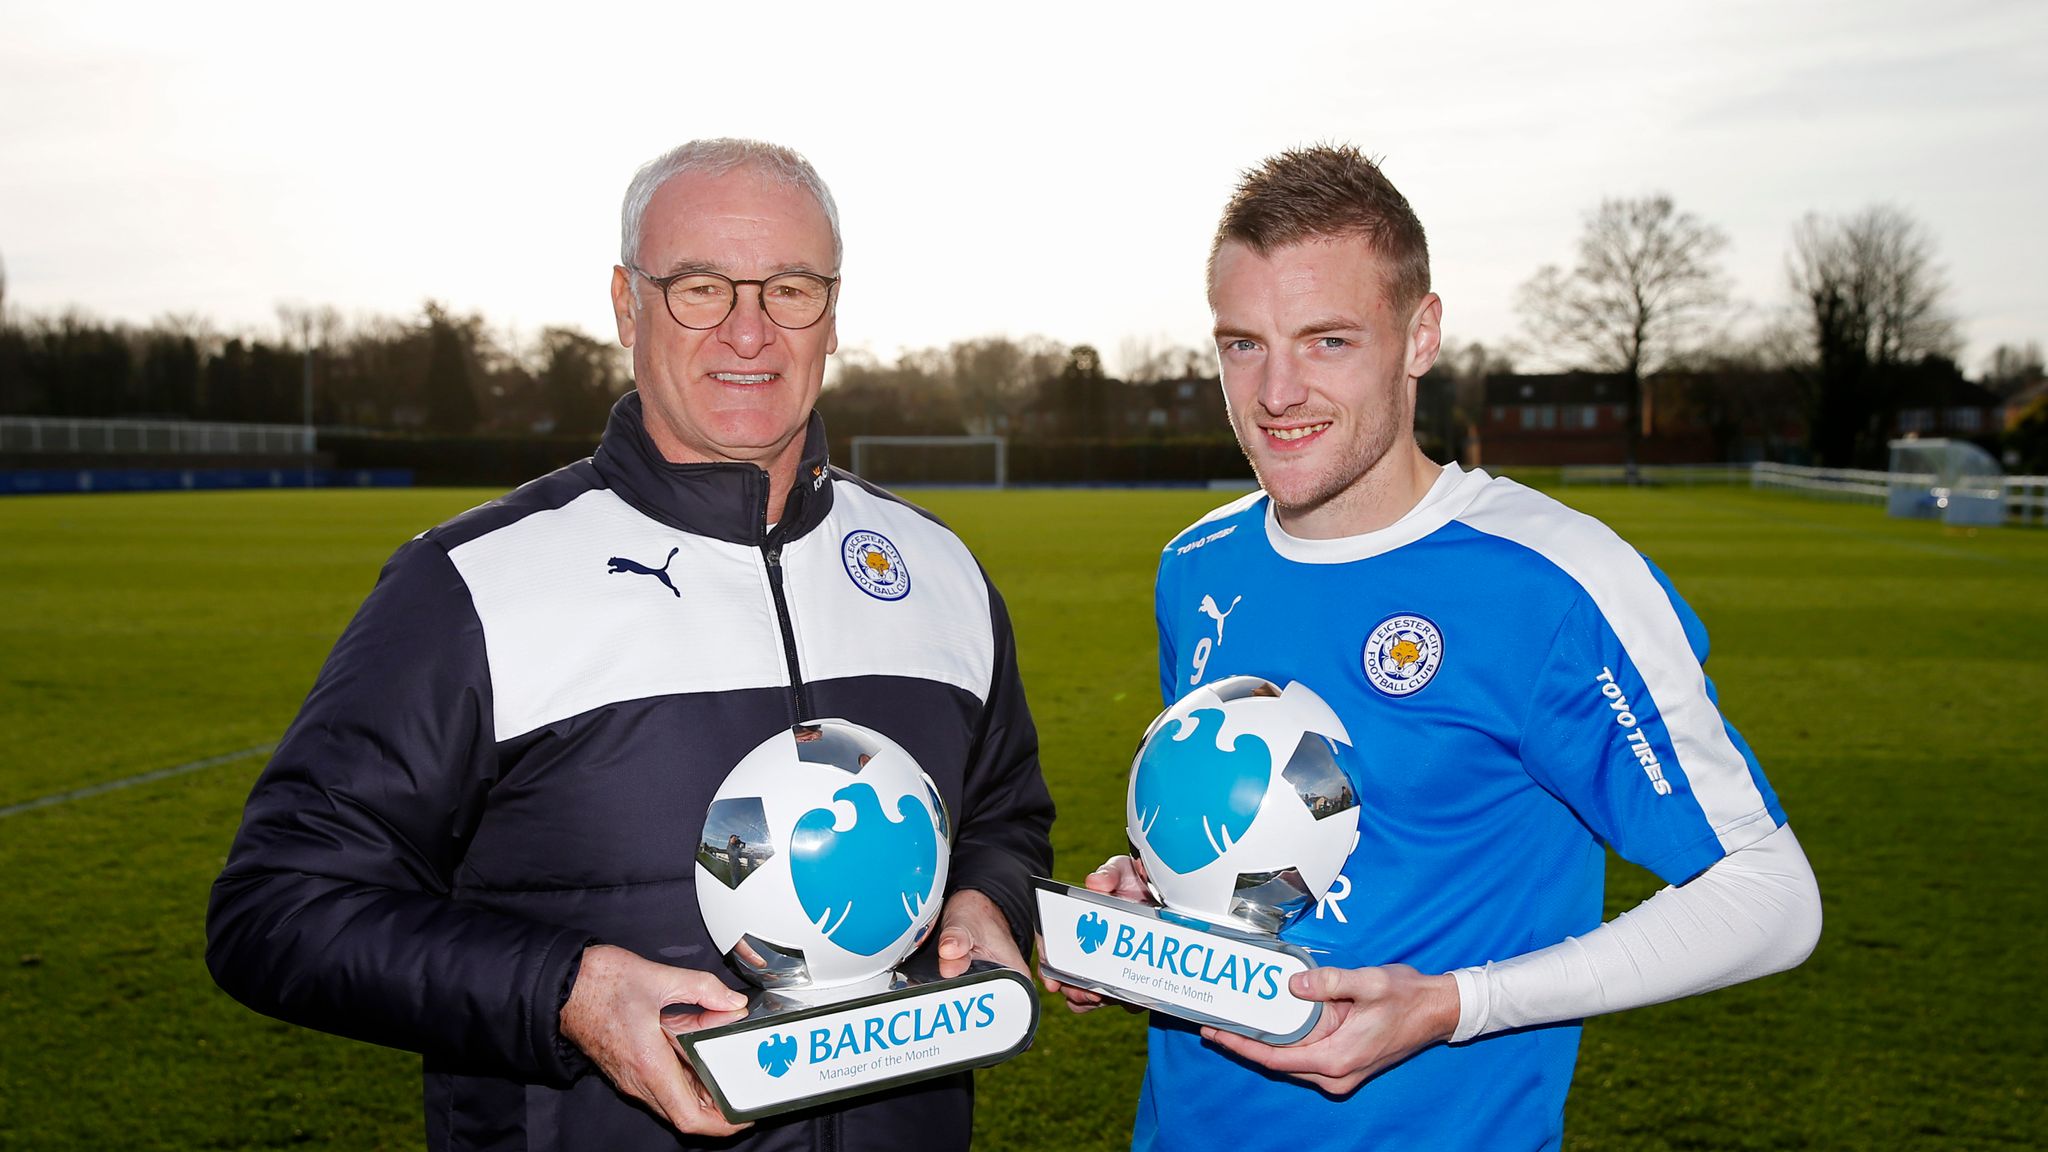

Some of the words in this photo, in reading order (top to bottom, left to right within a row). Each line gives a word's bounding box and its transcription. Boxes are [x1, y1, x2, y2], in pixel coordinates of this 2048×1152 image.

[848, 534, 885, 559] LEICESTER
[886, 544, 903, 567] CITY
[850, 564, 899, 596] FOOTBALL
[1371, 619, 1431, 645] LEICESTER
[1428, 633, 1439, 658] CITY
[1190, 637, 1212, 685] 9
[1367, 651, 1408, 691] FOOTBALL
[1408, 663, 1434, 689] CLUB
[1596, 666, 1637, 728] TOYO
[1626, 727, 1673, 796] TIRES
[1112, 924, 1283, 1001] BARCLAYS
[1122, 967, 1151, 985] Player
[1151, 977, 1163, 989] of
[1164, 980, 1180, 994] the
[1181, 985, 1214, 1004] Month
[809, 993, 996, 1065] BARCLAYS
[819, 1063, 868, 1081] Manager
[871, 1056, 882, 1069] of
[885, 1055, 902, 1067] the
[904, 1045, 940, 1062] Month
